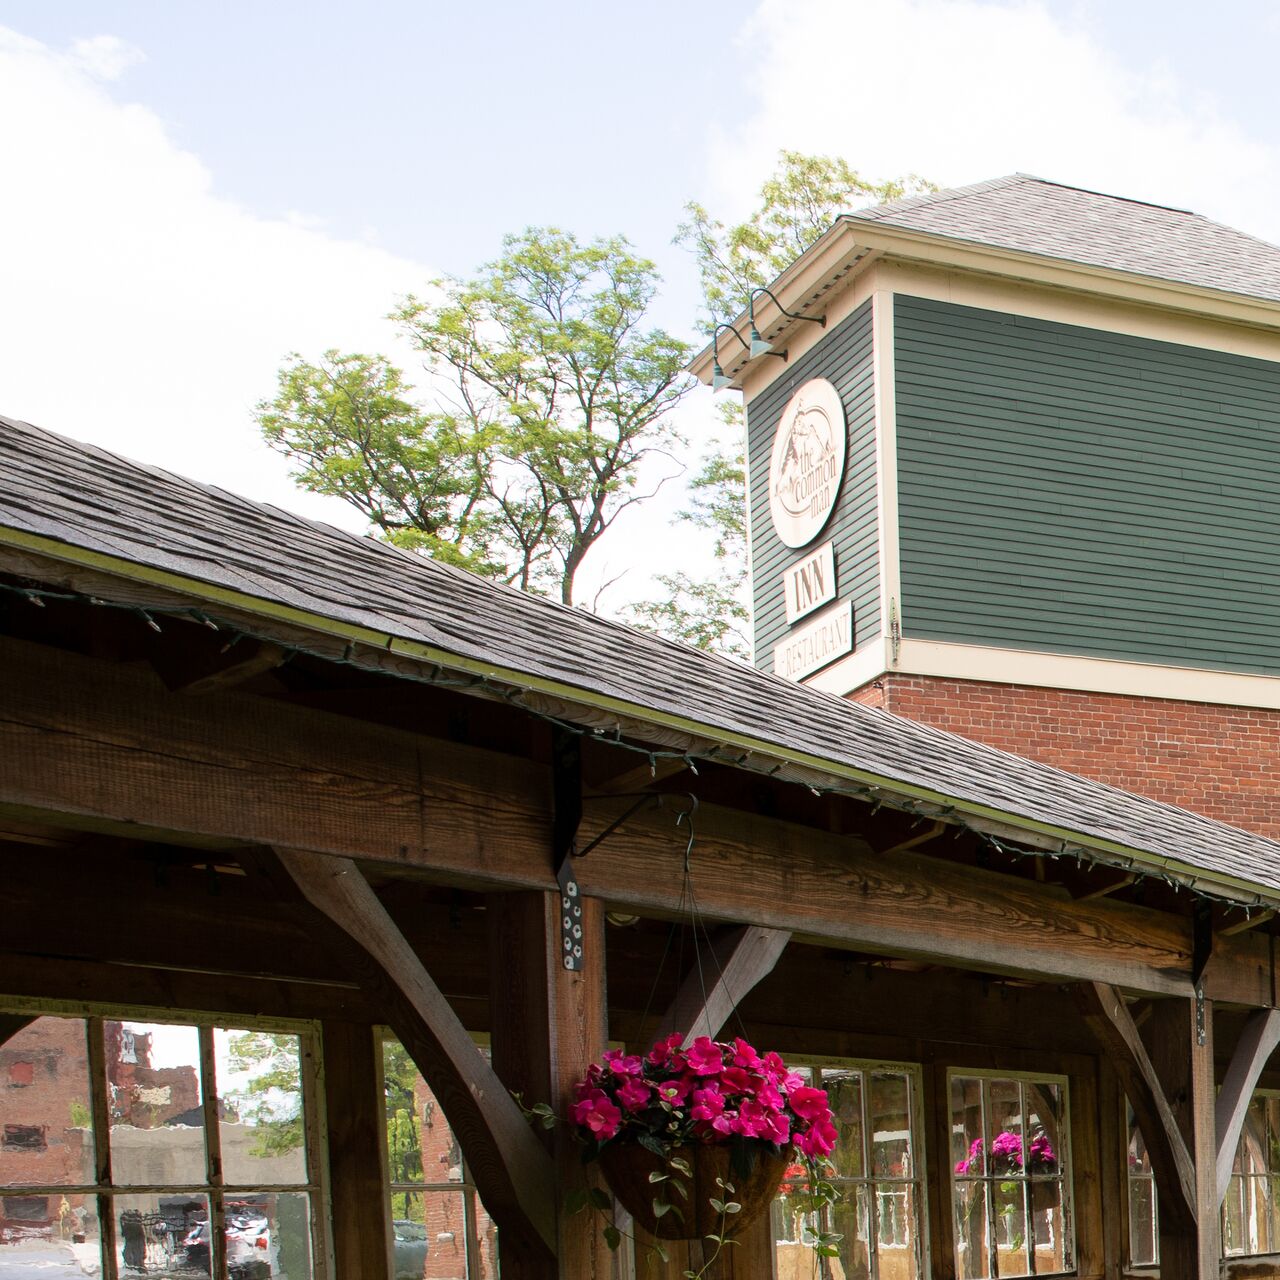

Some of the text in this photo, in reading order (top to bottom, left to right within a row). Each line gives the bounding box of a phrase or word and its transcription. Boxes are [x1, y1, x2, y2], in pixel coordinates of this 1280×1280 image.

[795, 454, 836, 503] common
[800, 441, 814, 475] the
[811, 485, 830, 519] man
[794, 554, 824, 612] INN
[785, 612, 849, 677] RESTAURANT
